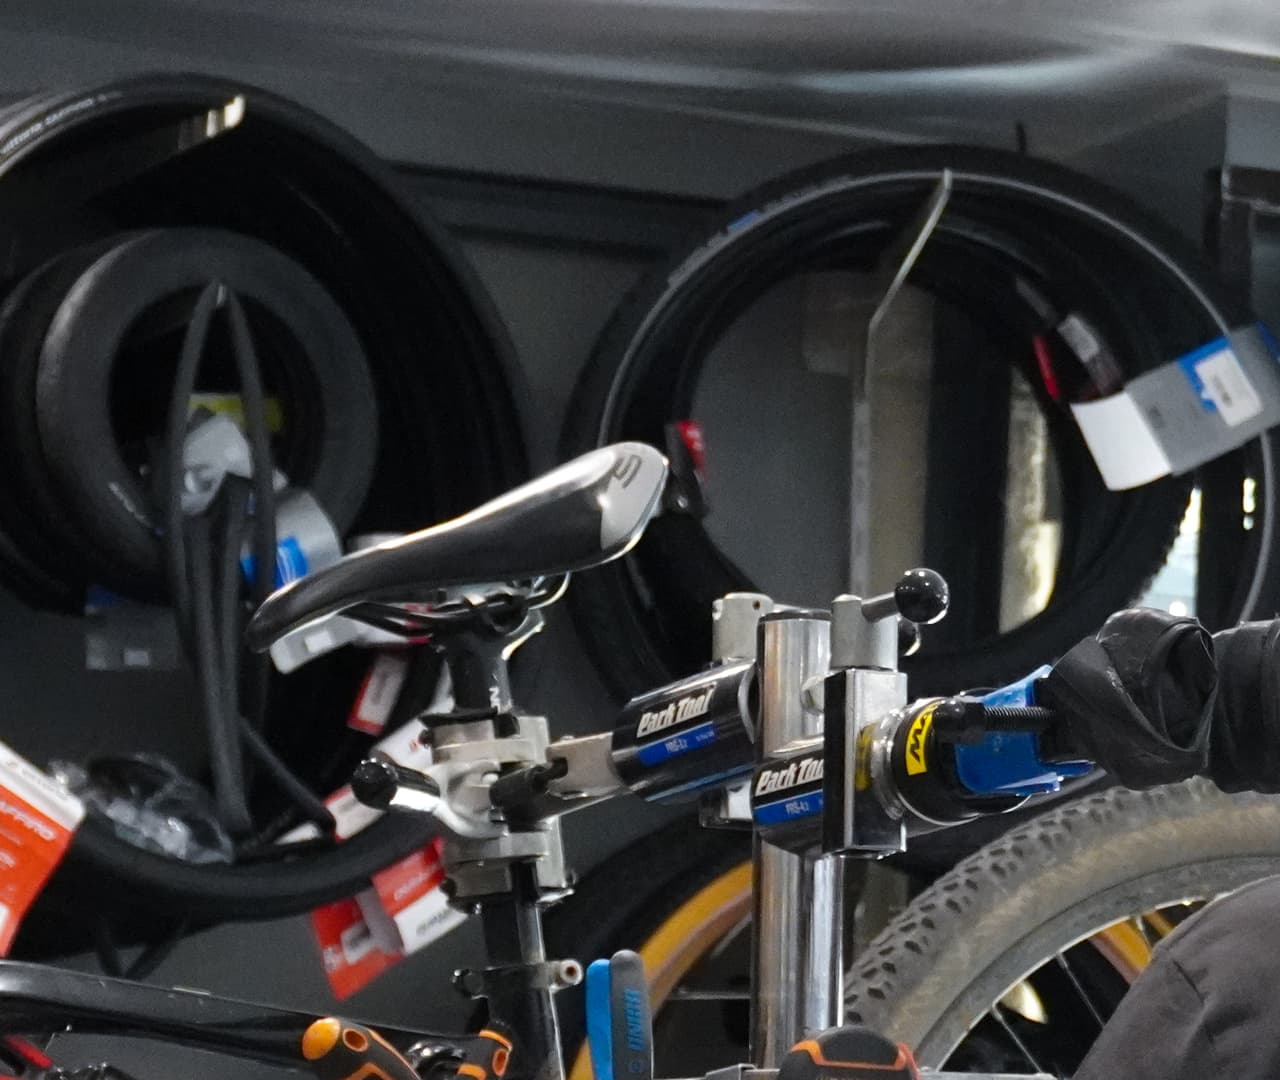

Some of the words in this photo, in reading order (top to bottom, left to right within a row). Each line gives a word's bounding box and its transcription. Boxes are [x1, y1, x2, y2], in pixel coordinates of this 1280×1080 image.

[636, 704, 679, 738] Park
[675, 681, 718, 720] Tool
[754, 762, 797, 797] Park
